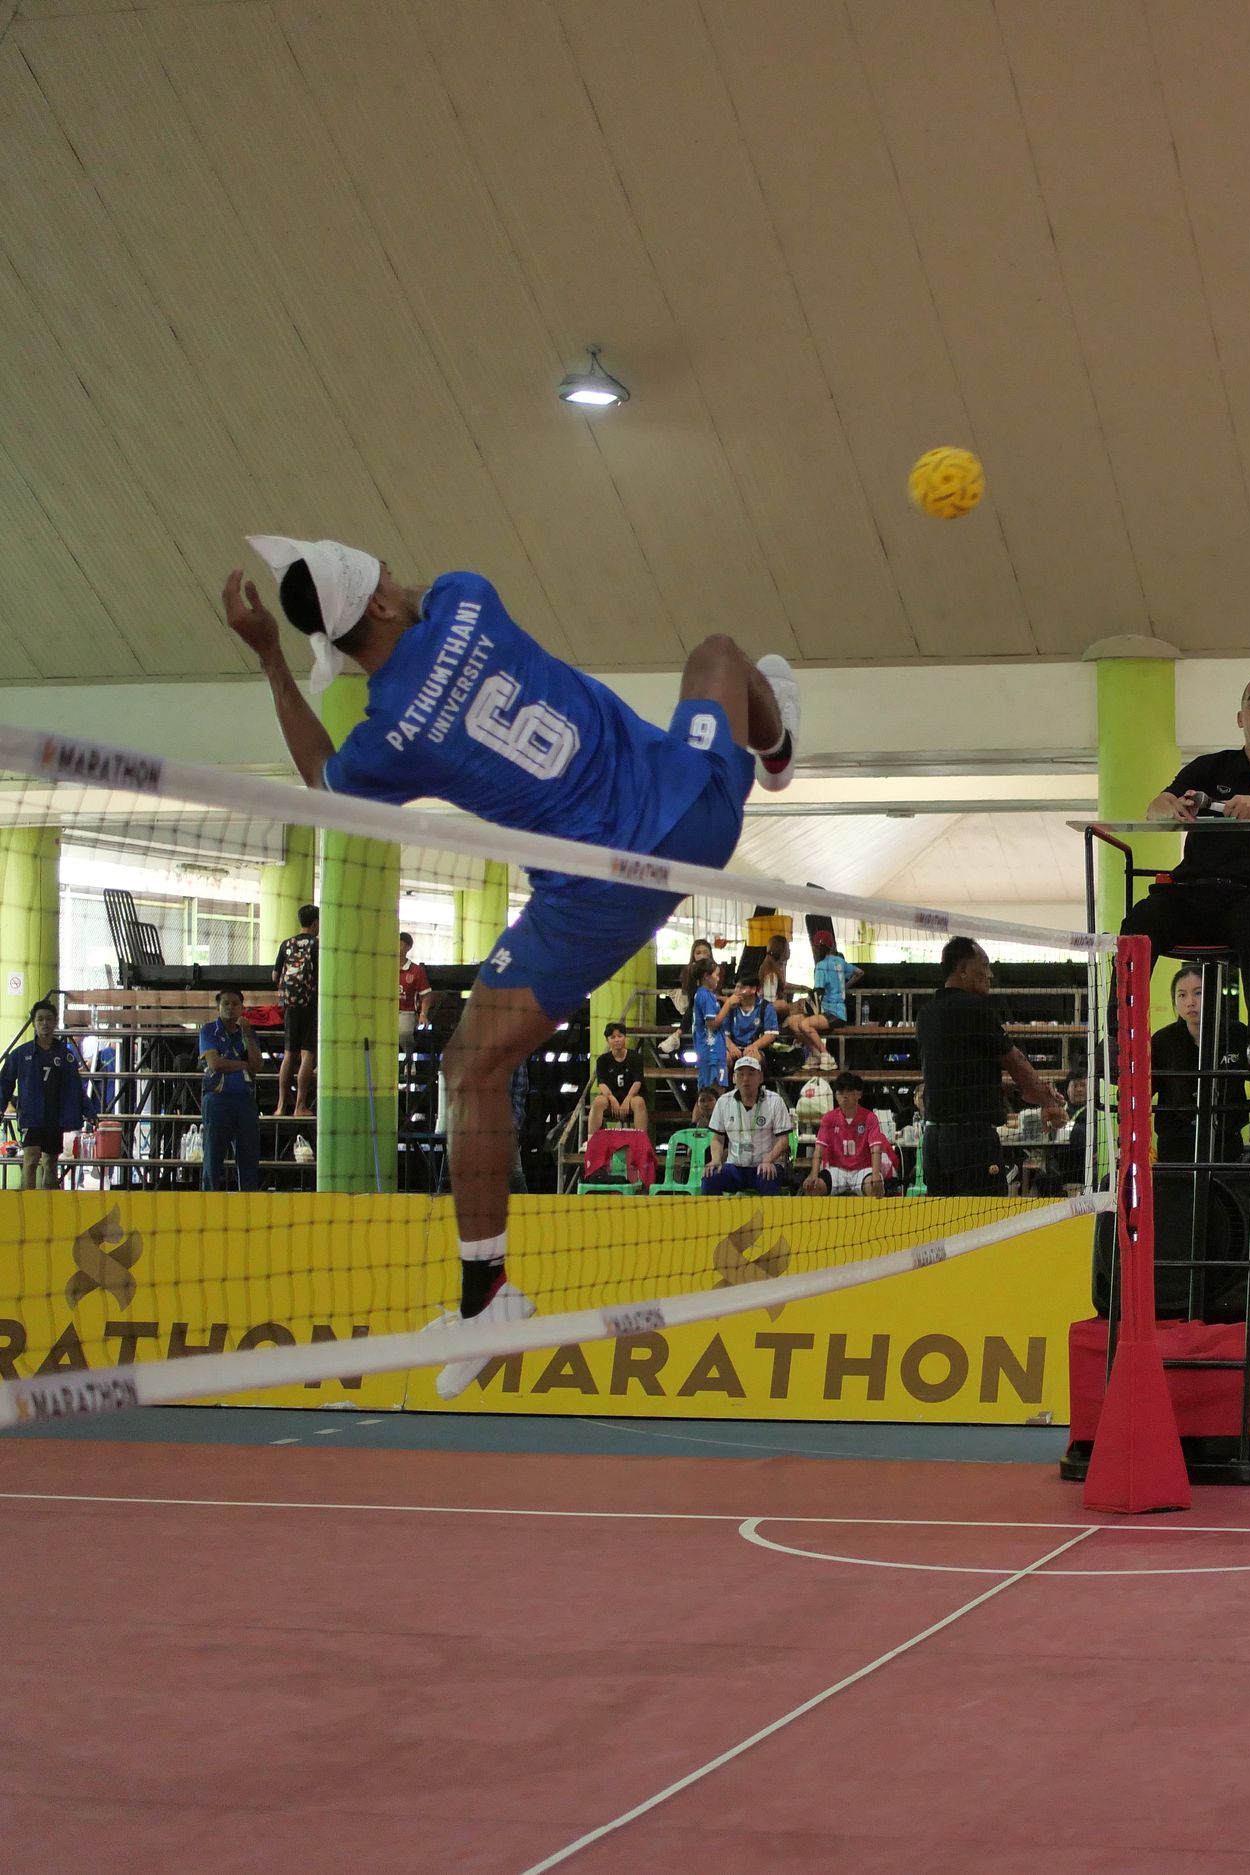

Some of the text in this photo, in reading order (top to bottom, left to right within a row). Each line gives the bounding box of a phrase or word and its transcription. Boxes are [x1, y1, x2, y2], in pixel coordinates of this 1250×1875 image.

[386, 602, 482, 751] PATHUMTHANI
[427, 634, 496, 743] UNIVERSITY
[465, 671, 580, 780] 6
[57, 743, 162, 793] MARATHON
[43, 1066, 51, 1082] 7
[617, 1074, 624, 1088] 6
[842, 1140, 856, 1156] 10
[31, 1379, 138, 1414] MARATHON
